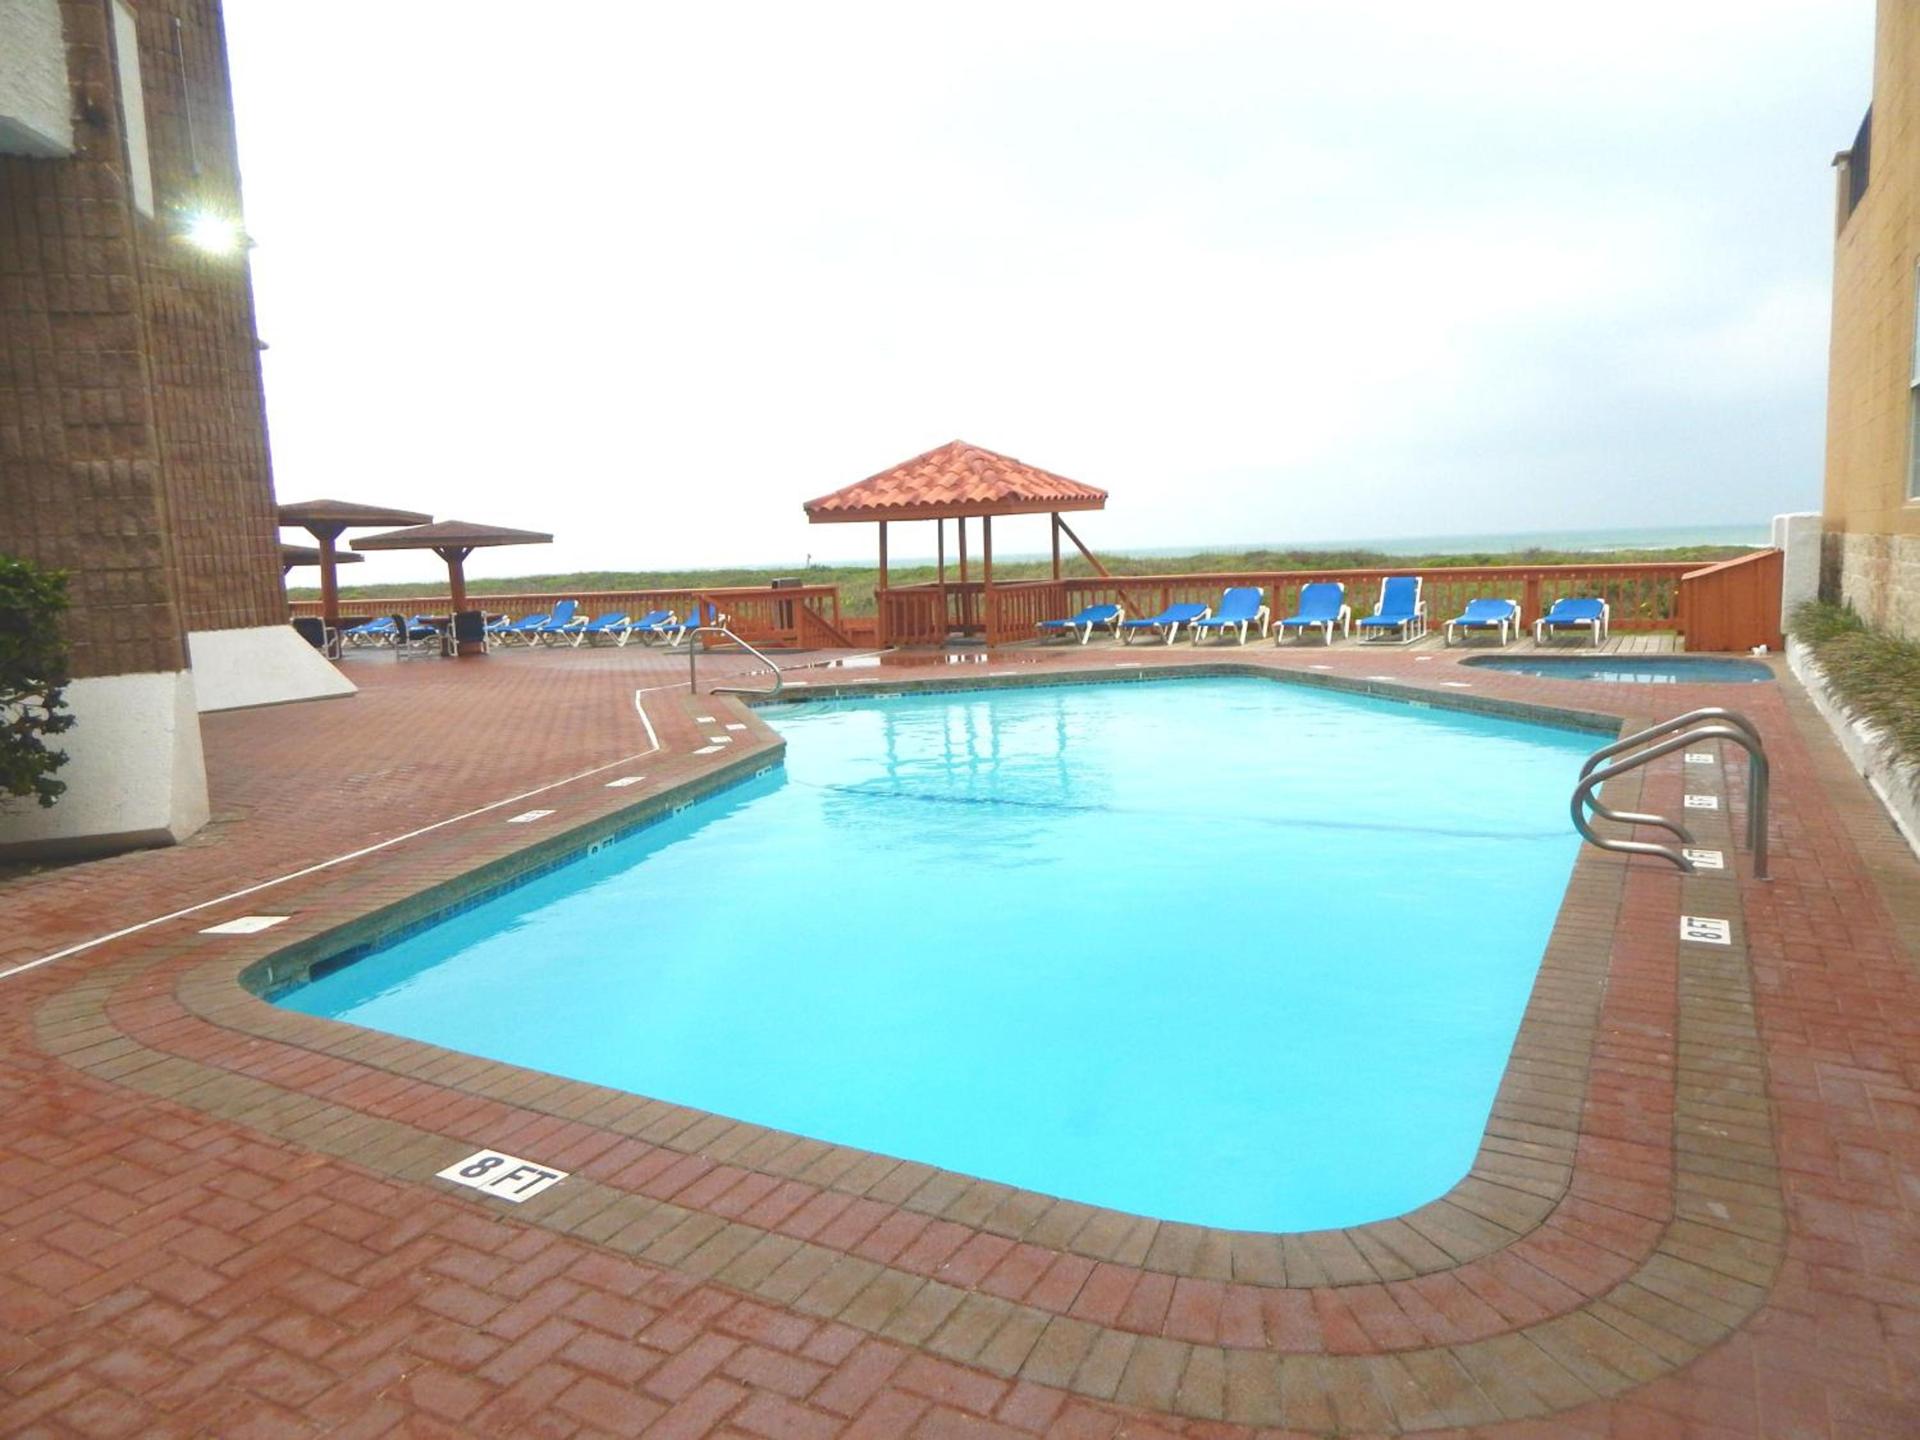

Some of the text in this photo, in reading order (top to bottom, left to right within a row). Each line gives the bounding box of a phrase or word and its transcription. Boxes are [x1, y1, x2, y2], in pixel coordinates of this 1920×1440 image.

[1687, 917, 1722, 940] 8 FT
[458, 1156, 559, 1194] 8 FT
